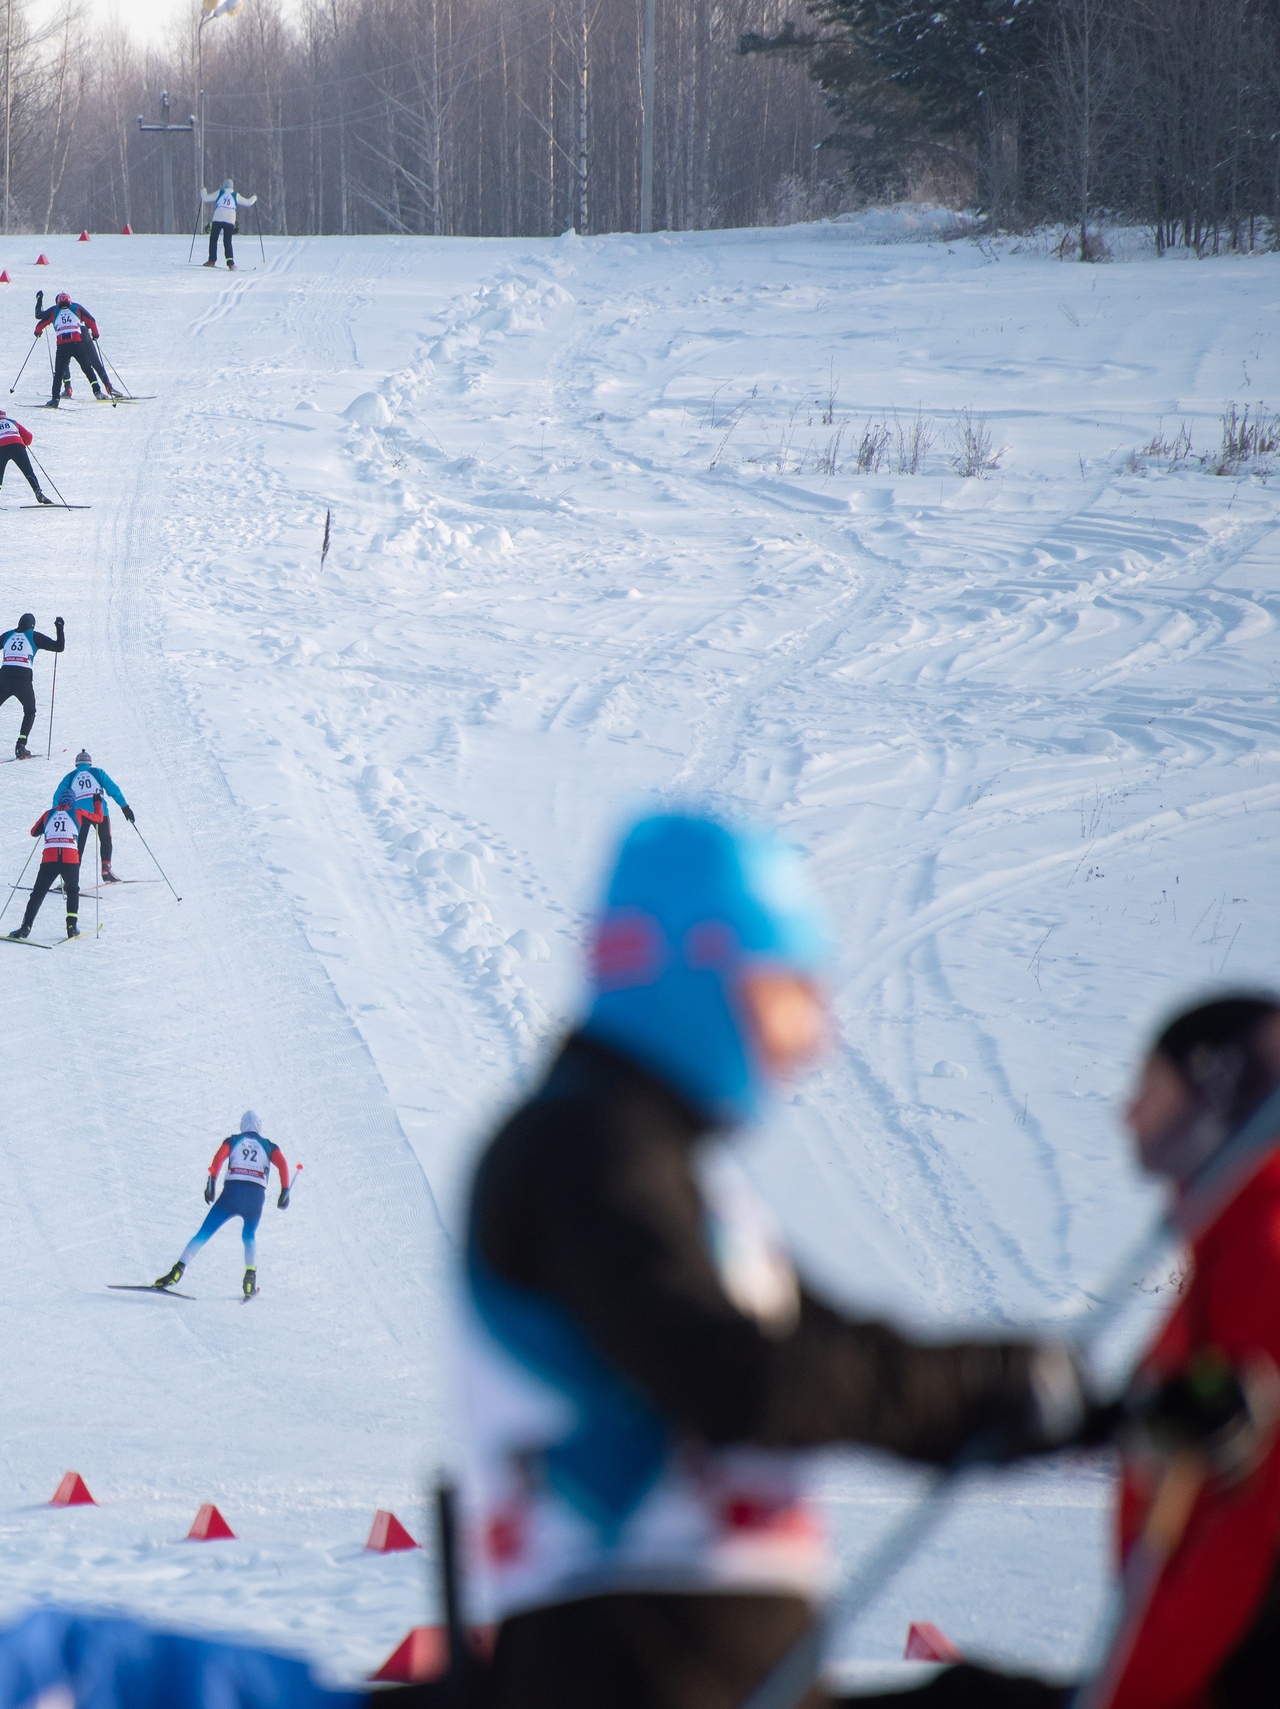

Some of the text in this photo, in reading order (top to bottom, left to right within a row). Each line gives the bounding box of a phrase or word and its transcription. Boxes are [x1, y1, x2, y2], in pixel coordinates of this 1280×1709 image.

[61, 316, 72, 324] 54
[0, 422, 10, 430] 88
[11, 641, 24, 651] 63
[78, 779, 91, 790] 90
[54, 821, 66, 832] 91
[242, 1148, 257, 1163] 92
